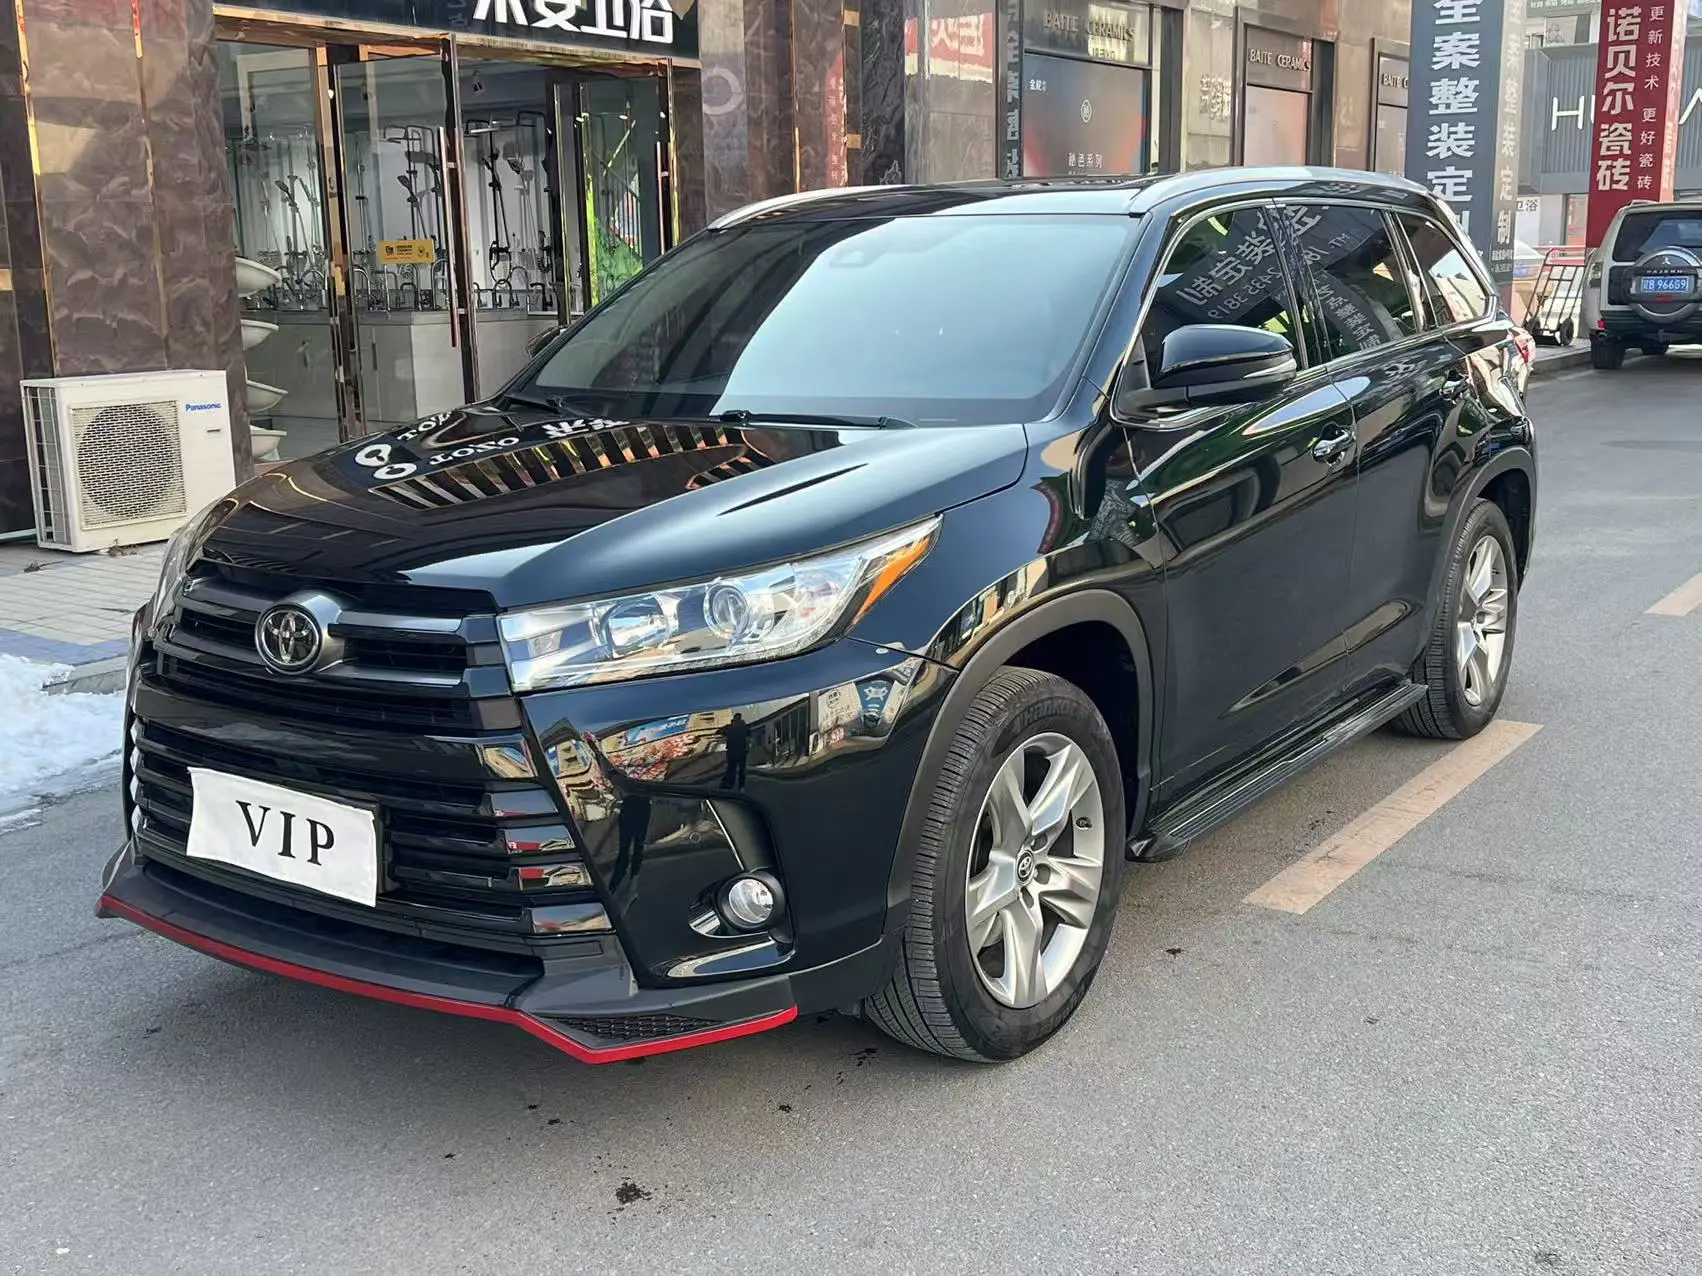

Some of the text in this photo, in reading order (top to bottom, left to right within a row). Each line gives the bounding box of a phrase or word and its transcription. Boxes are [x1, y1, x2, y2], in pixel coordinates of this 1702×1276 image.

[1043, 10, 1136, 41] BAITE CERAMICS
[1250, 49, 1311, 72] BAITE CERAMICS
[1425, 0, 1482, 236] 全案整装定
[1597, 6, 1642, 191] 诺贝尔瓷砖
[1637, 6, 1665, 190] 更新技术 更好瓷砖
[185, 403, 222, 411] Panasonic
[236, 800, 335, 866] VIP
